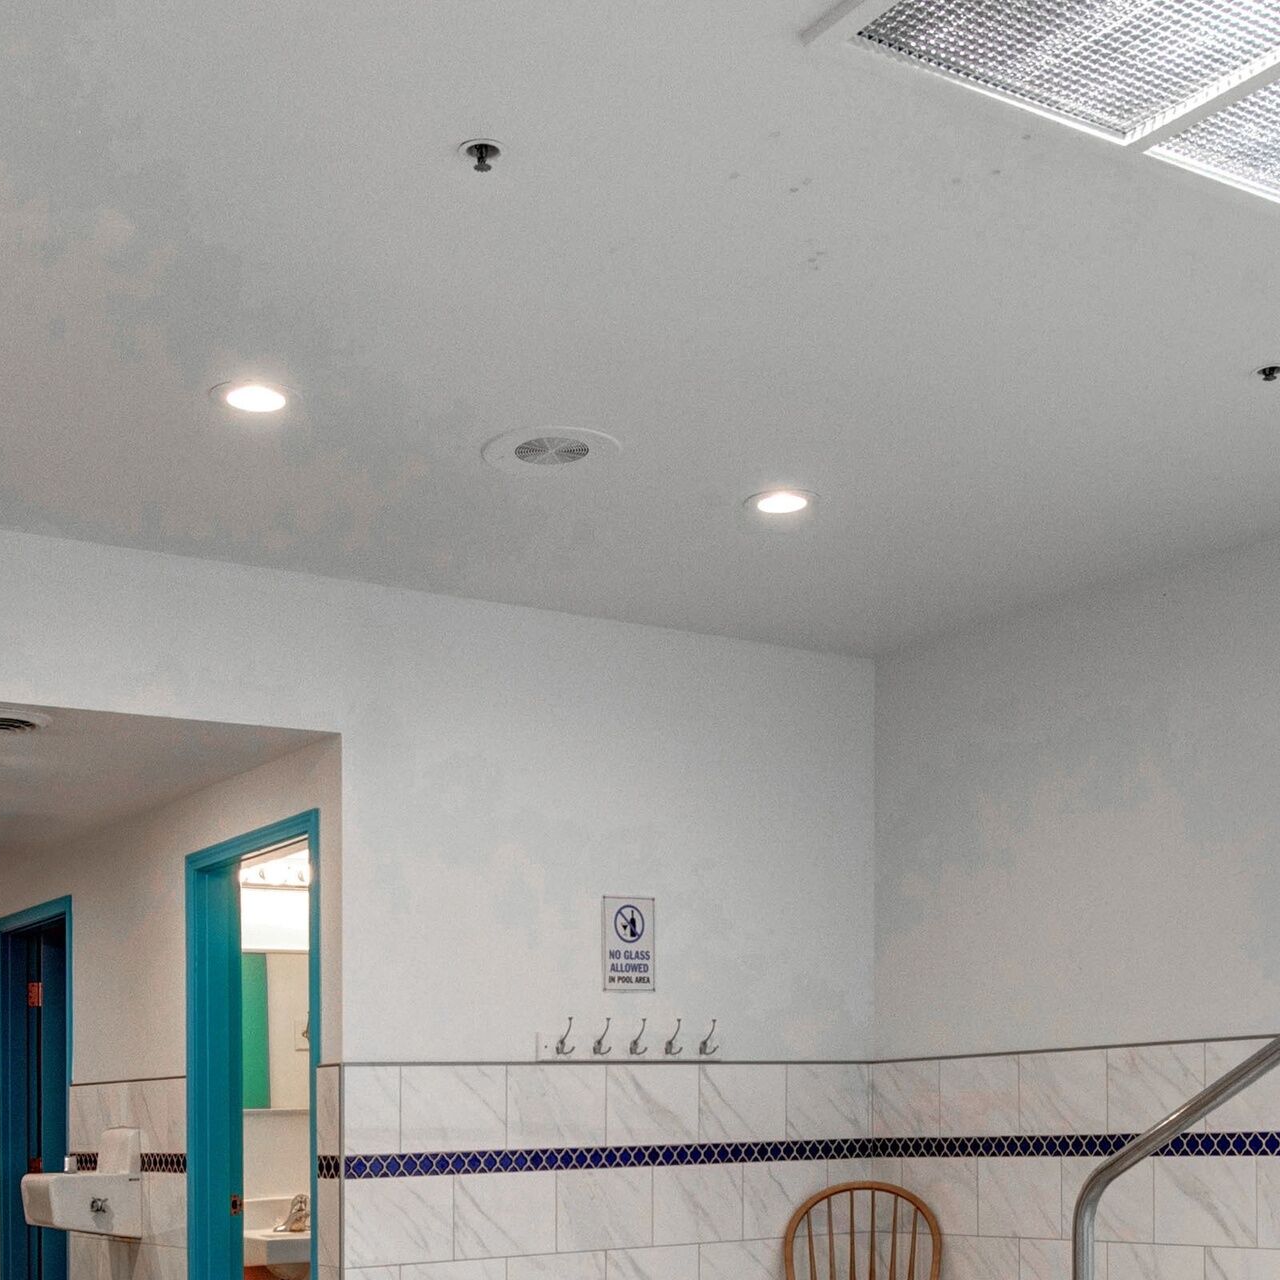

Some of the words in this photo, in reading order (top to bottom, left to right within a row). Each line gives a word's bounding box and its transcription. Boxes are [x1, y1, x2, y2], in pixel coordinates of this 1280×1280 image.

[609, 949, 621, 960] NO
[623, 950, 651, 960] GLASS
[610, 963, 649, 973] ALLOWED
[608, 975, 616, 984] IN
[617, 975, 634, 984] POOL
[635, 976, 651, 984] AREA
